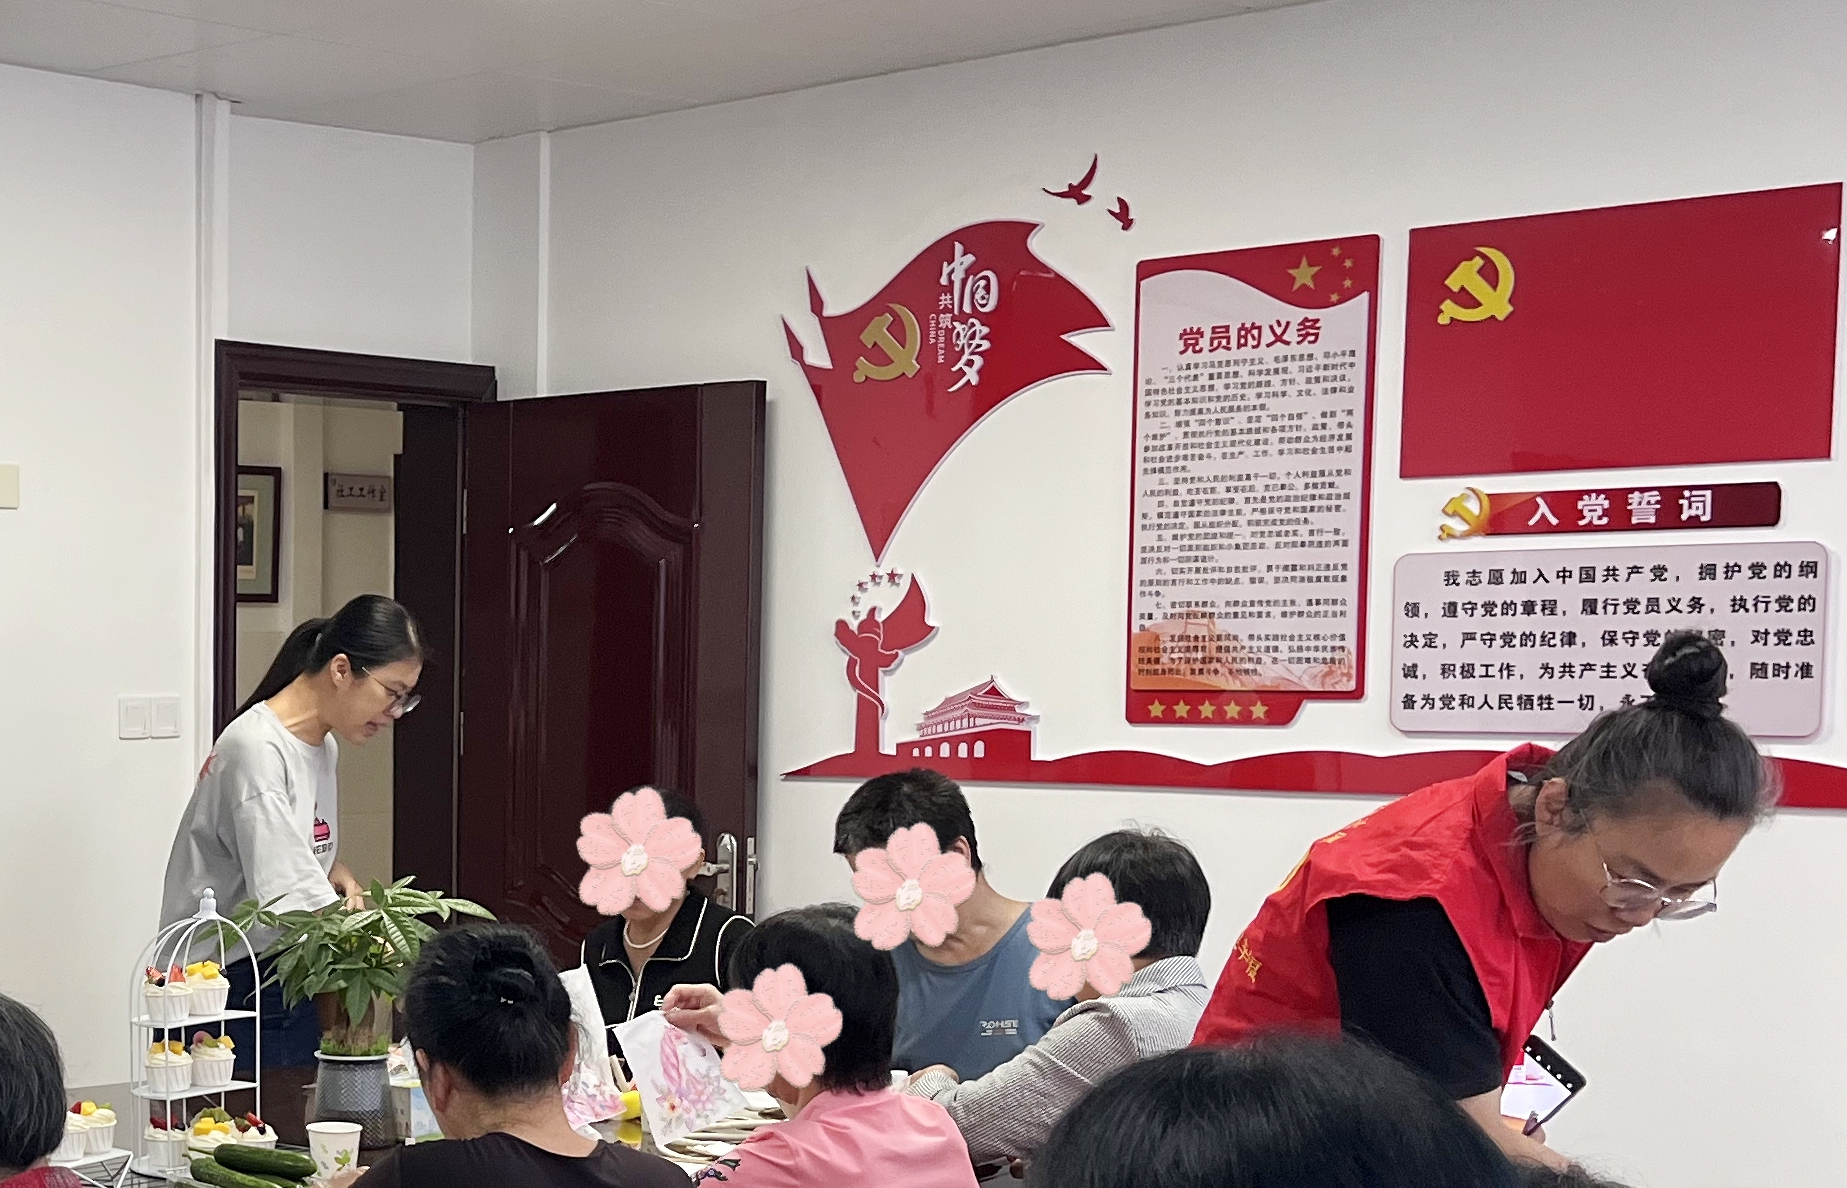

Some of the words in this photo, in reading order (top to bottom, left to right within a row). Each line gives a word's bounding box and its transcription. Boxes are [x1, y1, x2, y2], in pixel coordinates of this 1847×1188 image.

[939, 241, 999, 392] 中国梦
[1178, 316, 1322, 356] 党员的义务
[1527, 489, 1713, 527] 入党誓词
[1443, 560, 1819, 587] 我志愿加入中国共产党，拥护党的纲
[1403, 595, 1817, 618] 领，遵守党的章程，履行党员义务，执行党的
[1402, 628, 1816, 651] 决定，严守党的纪律，保守党密，对党忠
[1401, 661, 1815, 682] 诚，积极工作，为共产主义，随时准
